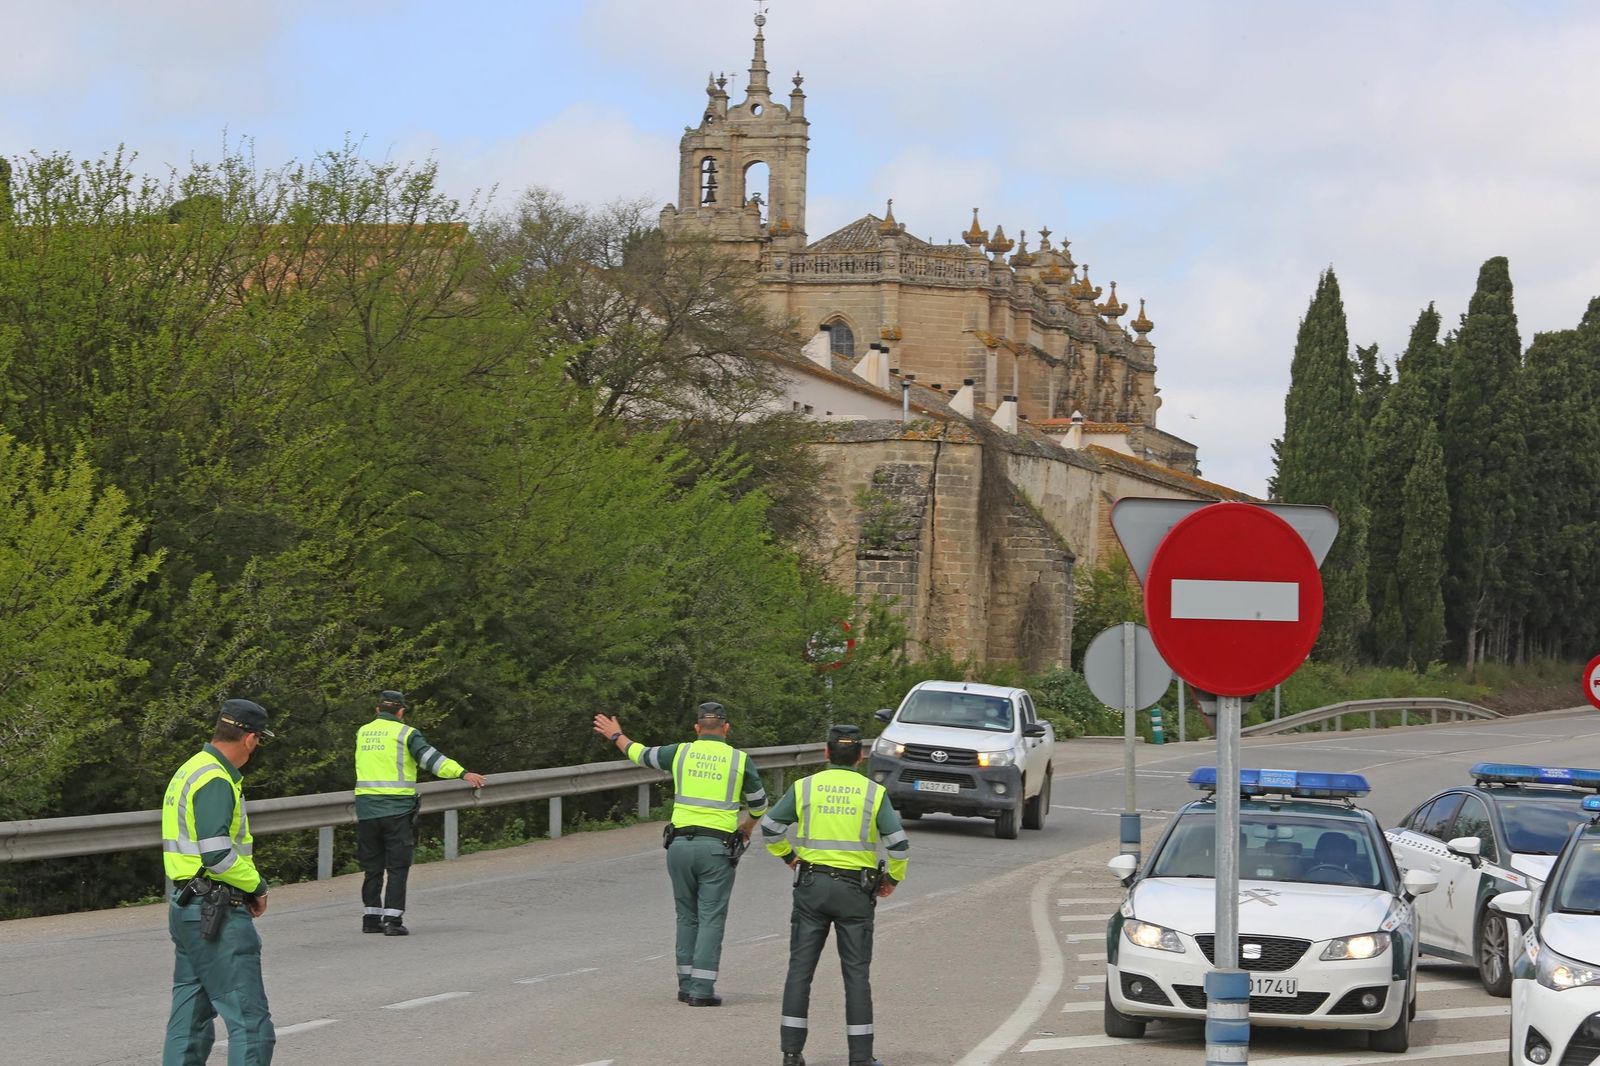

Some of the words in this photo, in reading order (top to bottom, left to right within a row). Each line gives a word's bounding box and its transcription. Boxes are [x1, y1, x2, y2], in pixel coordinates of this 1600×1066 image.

[690, 752, 727, 763] GUARDIA
[696, 761, 717, 771] CIVIL
[688, 769, 722, 781] TRAFICO
[817, 785, 861, 795] GUARDIA
[920, 782, 940, 791] 0437
[826, 795, 851, 804] CIVIL
[817, 805, 857, 815] TRAFICO
